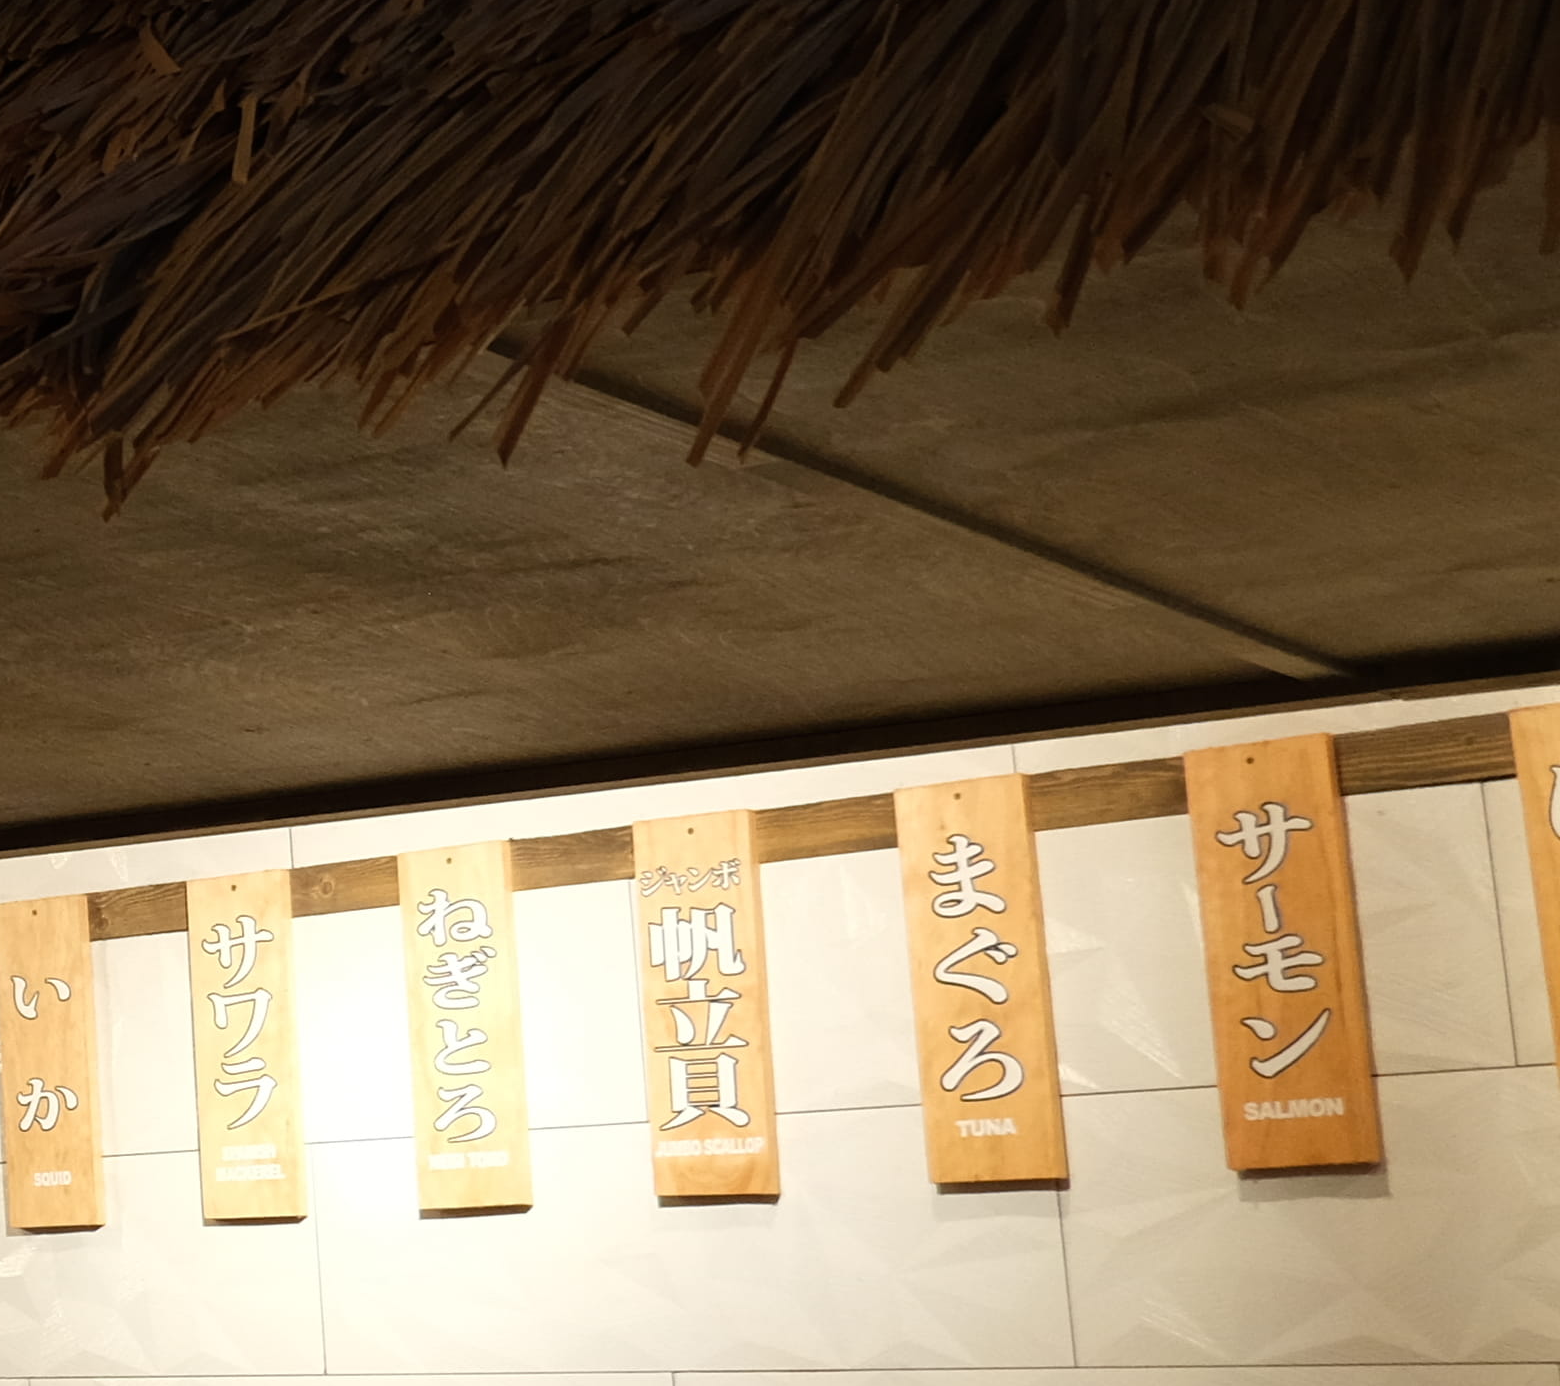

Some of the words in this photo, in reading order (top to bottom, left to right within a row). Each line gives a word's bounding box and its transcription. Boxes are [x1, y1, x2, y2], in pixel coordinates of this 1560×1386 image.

[640, 858, 741, 897] ジャンボ
[1216, 802, 1331, 1079] サーモン
[202, 915, 277, 1129] サワラ
[417, 888, 497, 1143] ねぎとろ
[647, 903, 751, 1131] 帆立貝
[929, 834, 1024, 1102] まぐろ
[11, 974, 79, 1132] いか
[956, 1118, 1016, 1137] TUNA
[1243, 1098, 1345, 1121] SALMON
[33, 1171, 72, 1187] SQUID
[703, 1136, 764, 1155] SCALLOP
